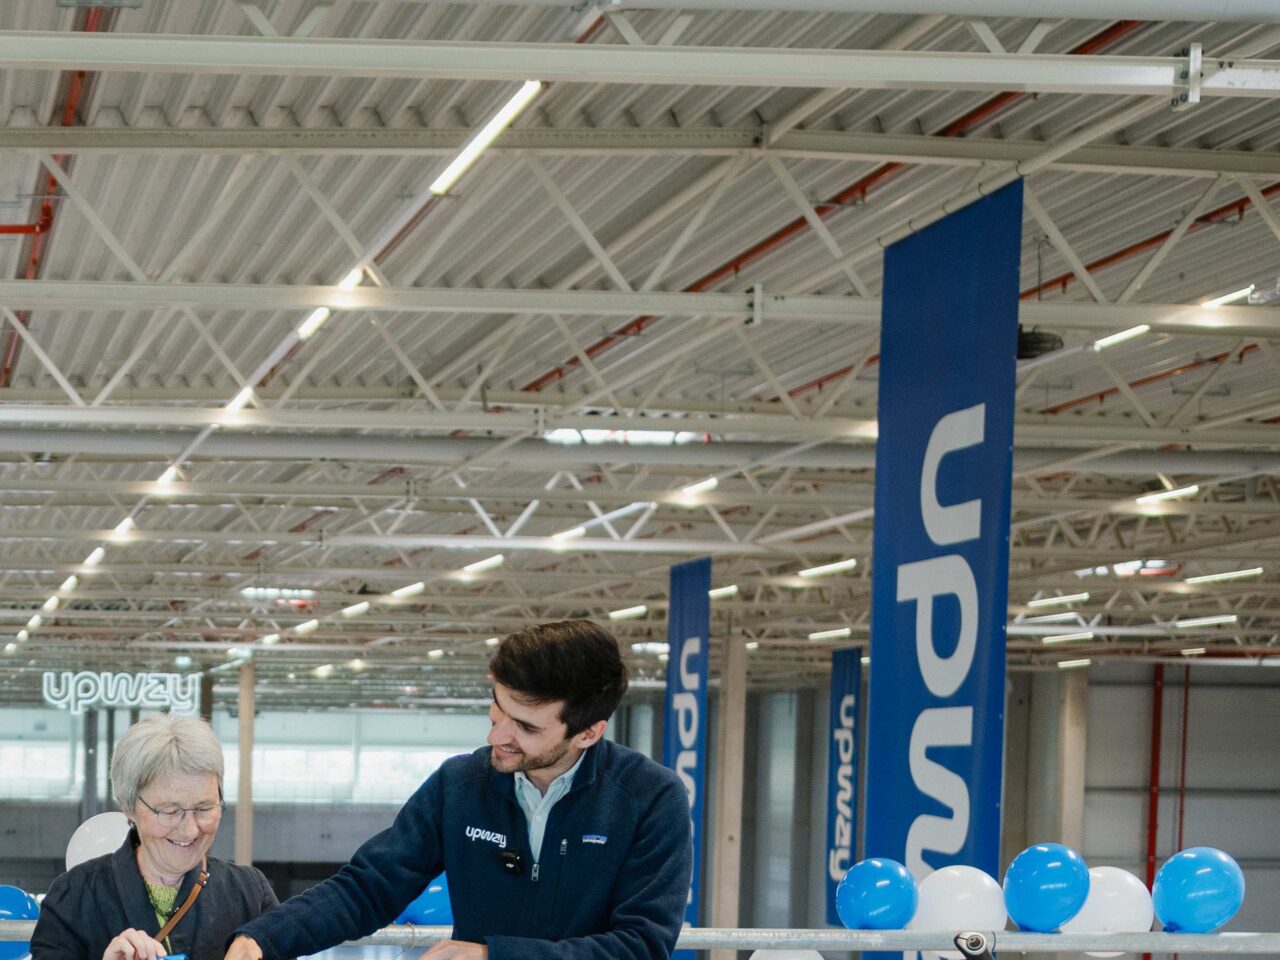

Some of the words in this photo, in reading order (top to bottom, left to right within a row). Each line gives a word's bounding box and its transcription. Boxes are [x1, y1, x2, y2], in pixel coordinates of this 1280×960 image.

[43, 671, 202, 716] upway
[829, 694, 855, 881] upway
[465, 826, 507, 848] upway
